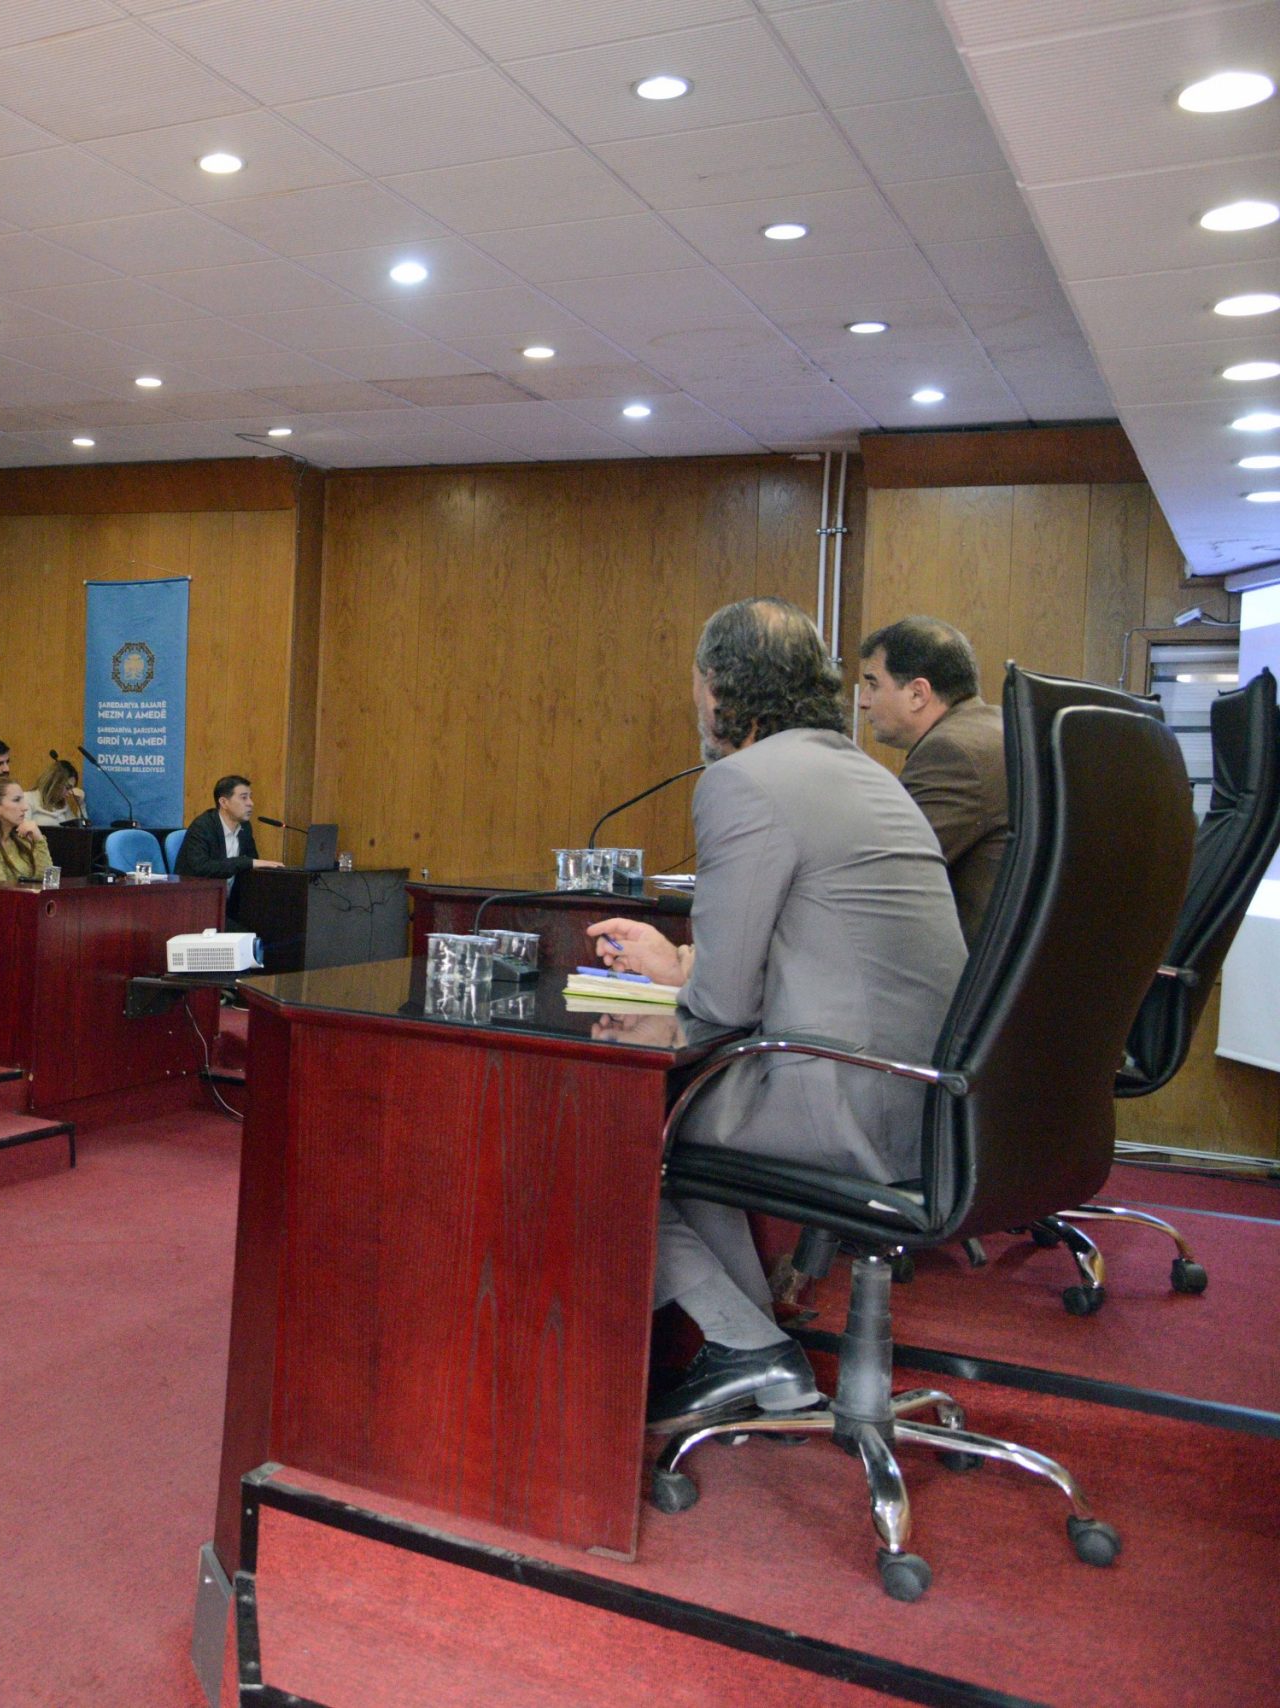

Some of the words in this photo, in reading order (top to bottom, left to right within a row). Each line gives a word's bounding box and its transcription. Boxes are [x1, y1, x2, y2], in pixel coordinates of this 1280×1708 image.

[140, 700, 167, 708] BAJARÊ
[98, 710, 124, 719] MEZIN
[126, 710, 133, 719] A
[135, 708, 167, 719] AMEDÊ
[122, 737, 134, 745] YA
[135, 734, 167, 746] AMEDÎ
